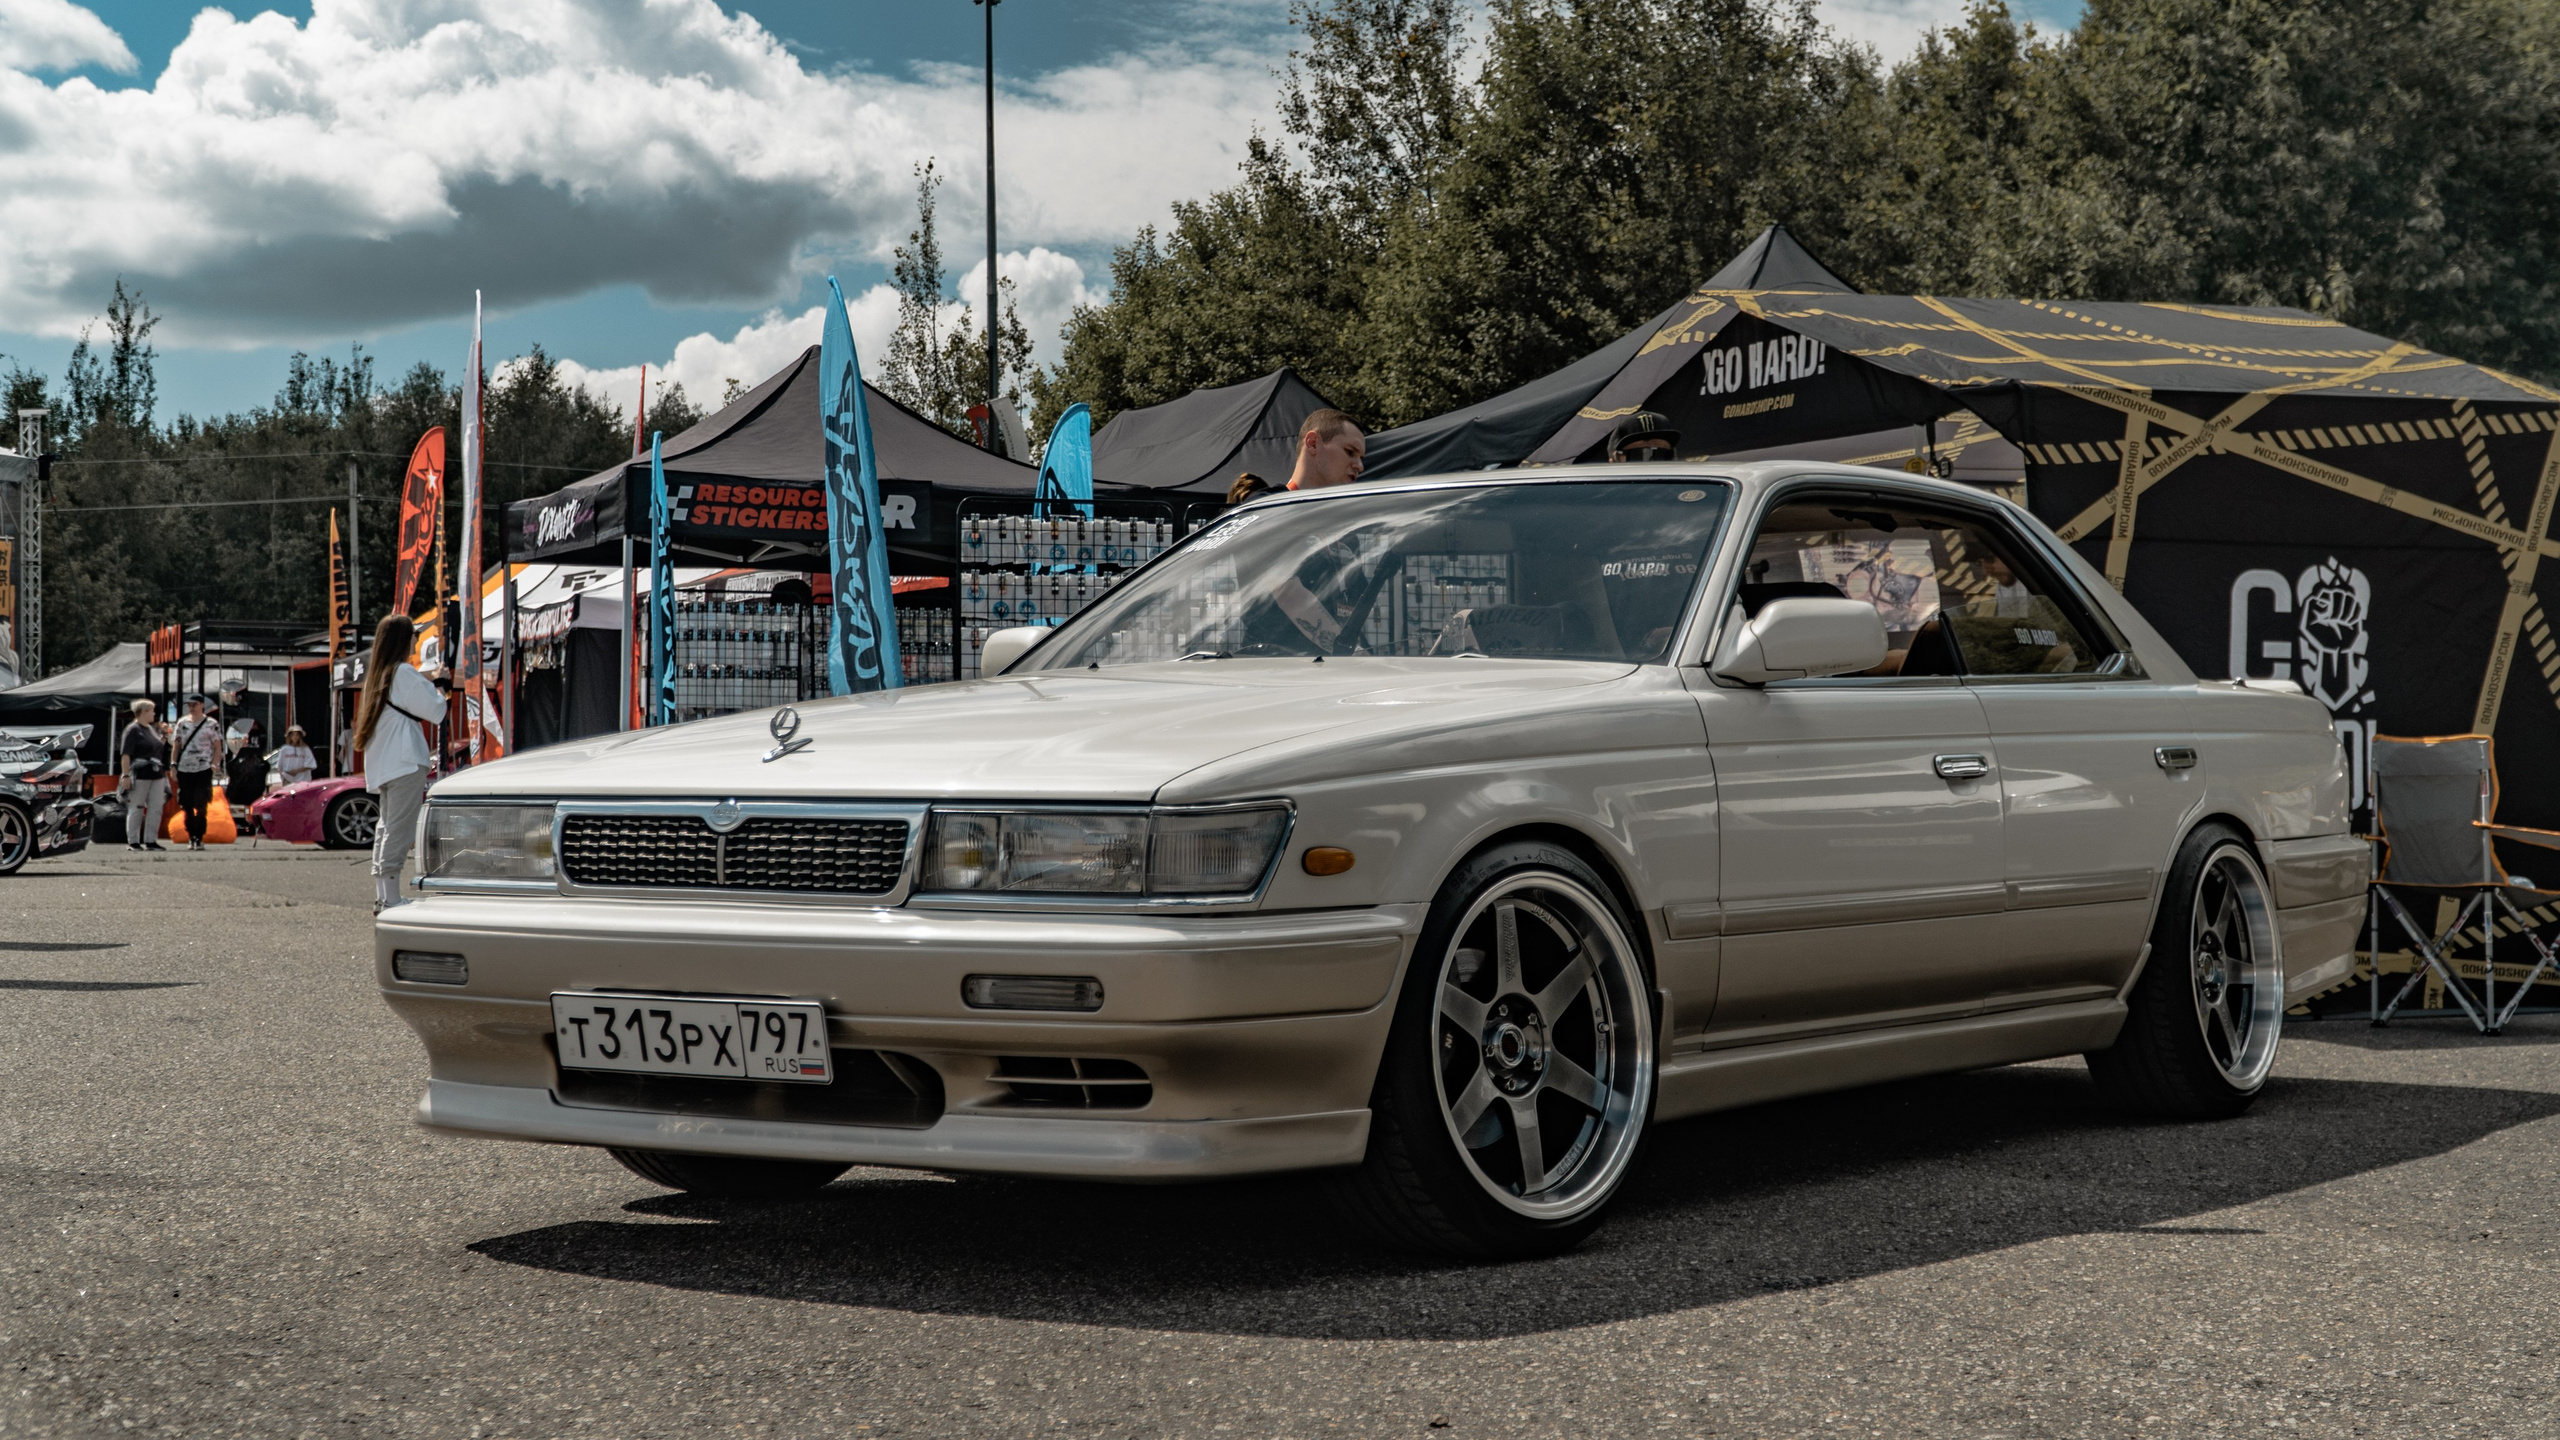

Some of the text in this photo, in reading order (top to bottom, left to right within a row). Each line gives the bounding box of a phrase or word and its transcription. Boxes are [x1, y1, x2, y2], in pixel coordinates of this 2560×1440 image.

[1748, 333, 1827, 390] HARD!
[1723, 393, 1795, 419] GOHARDSHOP.COM
[2253, 444, 2350, 487] GOHARDSHOP.COM
[2117, 440, 2141, 539] GOHARDSHOP.COM
[2527, 460, 2560, 552] GOHARDSHOP.COM
[690, 504, 829, 532] STICKERS
[2432, 506, 2526, 548] GOHARDSHOP.COM
[2480, 631, 2514, 726] GOHARDSHOP.COM
[740, 1010, 809, 1055] 797
[765, 1057, 799, 1074] RUS
